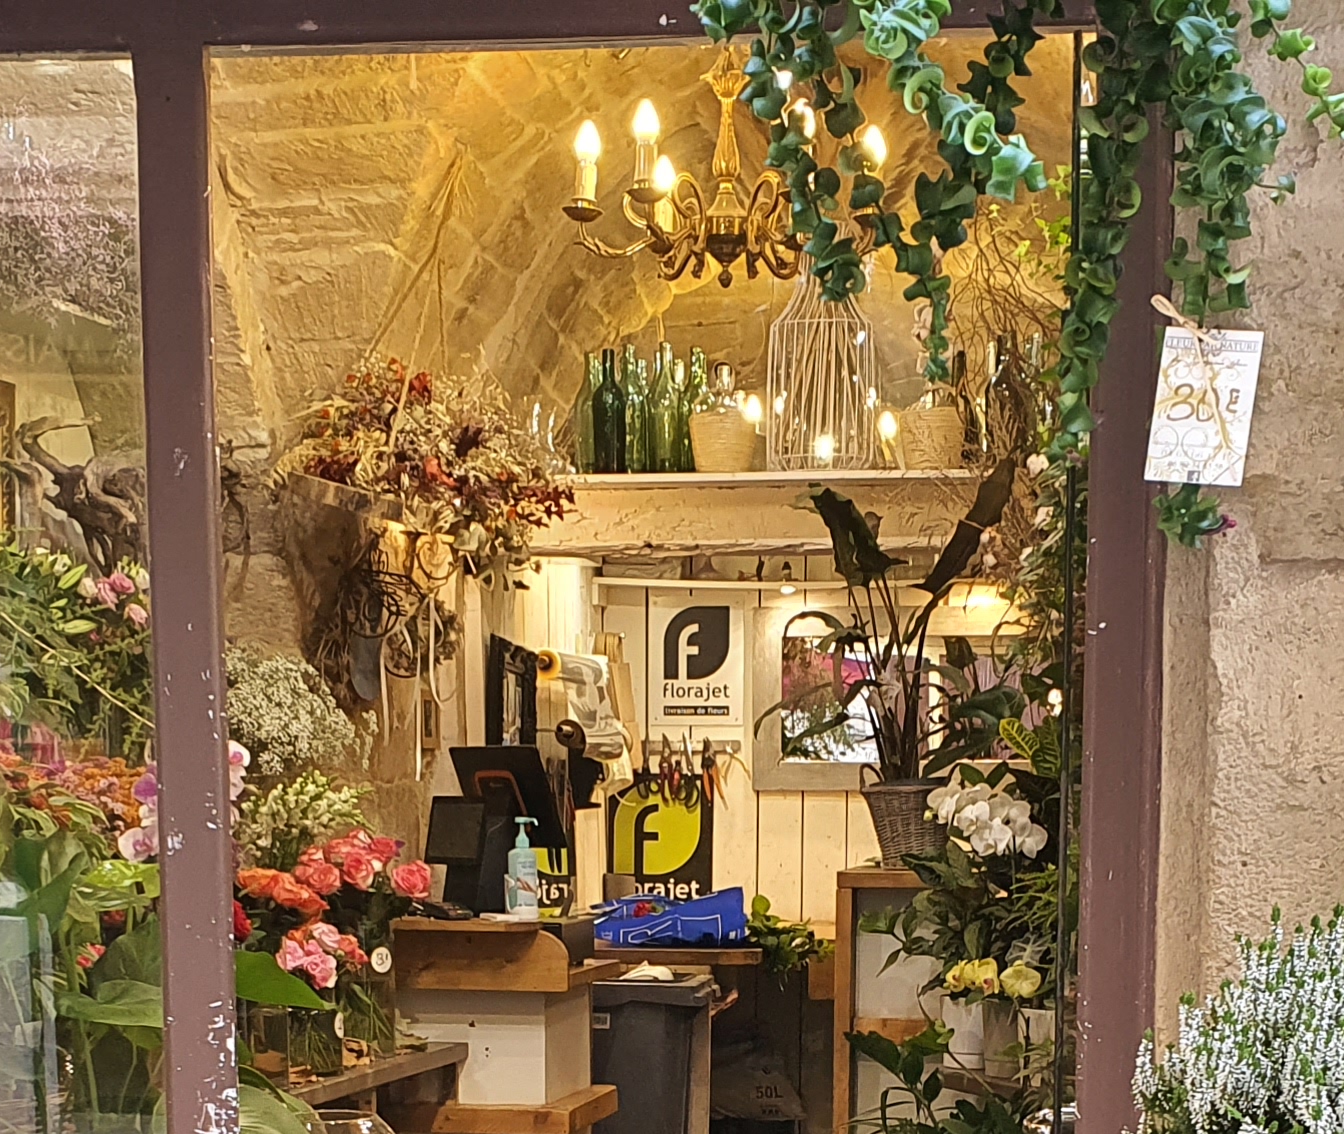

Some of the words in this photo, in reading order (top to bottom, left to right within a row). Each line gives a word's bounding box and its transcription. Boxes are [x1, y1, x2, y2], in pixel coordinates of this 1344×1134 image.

[663, 683, 729, 702] florajet
[696, 706, 706, 715] de
[635, 878, 700, 900] orajet
[756, 1086, 784, 1099] 50L
